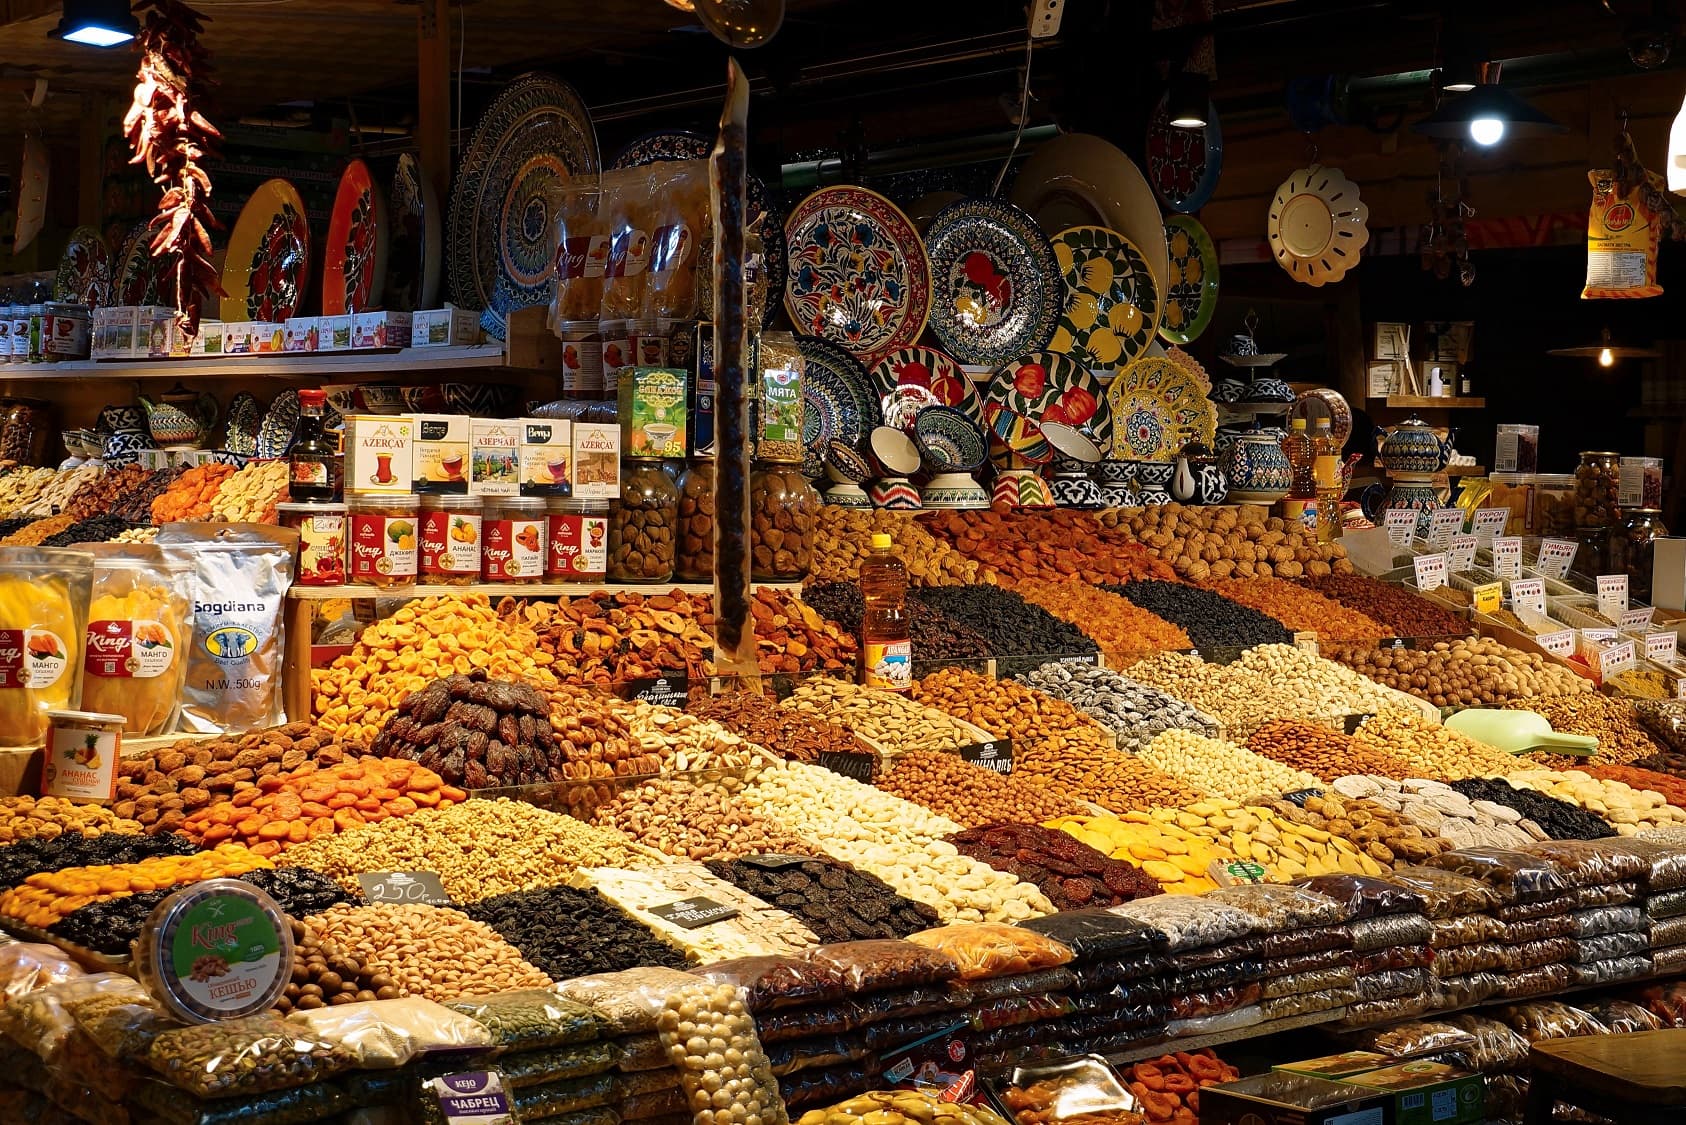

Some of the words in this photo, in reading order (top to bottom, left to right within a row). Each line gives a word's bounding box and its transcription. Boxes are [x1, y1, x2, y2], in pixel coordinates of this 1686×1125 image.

[768, 387, 797, 399] МЯТА
[362, 438, 407, 449] AZERÇAY
[478, 437, 516, 446] АЗЕРЧАЙ
[579, 440, 615, 450] AZERÇAY
[664, 440, 681, 453] 95
[353, 541, 383, 558] King
[418, 537, 445, 553] King
[551, 540, 579, 556] King
[1544, 543, 1574, 552] ТИМЬЯН
[482, 546, 511, 560] King
[195, 600, 265, 615] Sogdiana
[86, 631, 132, 653] King
[0, 647, 22, 663] ng
[62, 769, 97, 778] АНАНАС
[192, 922, 238, 950] King
[208, 978, 257, 1000] КЕШЬЮ
[450, 1096, 500, 1109] ЧАБРЕЦ
